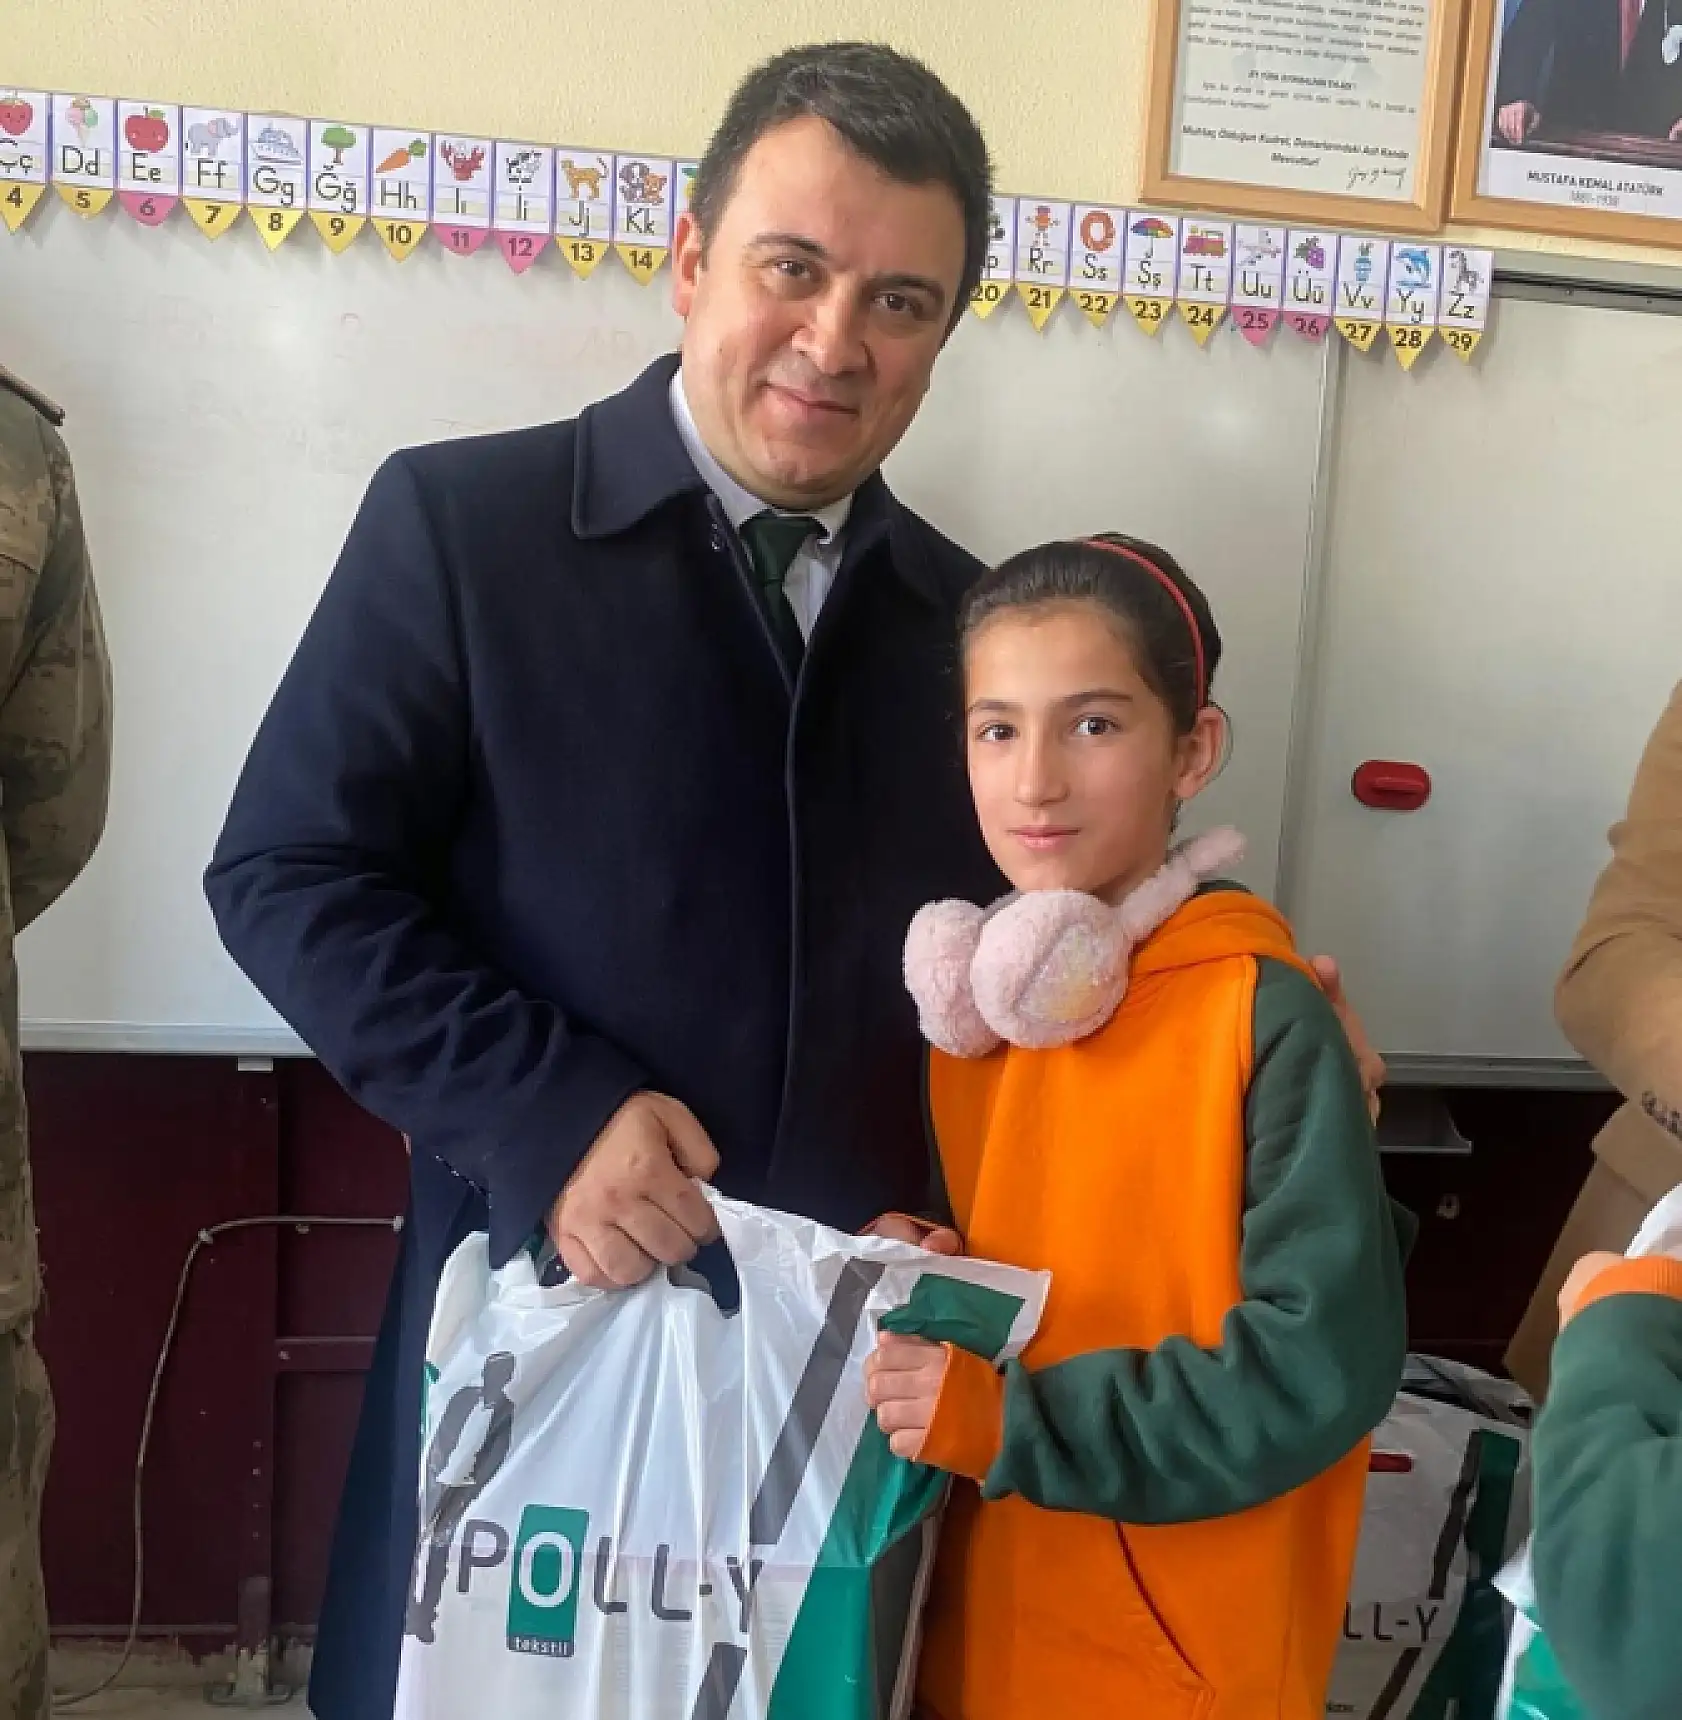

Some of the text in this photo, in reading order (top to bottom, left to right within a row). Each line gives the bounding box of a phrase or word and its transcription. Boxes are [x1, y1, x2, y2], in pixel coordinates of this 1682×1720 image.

[62, 145, 99, 176] Dd
[132, 153, 161, 182] Ee
[197, 158, 227, 188] Ff
[5, 186, 23, 208] 4
[253, 165, 294, 208] Gg
[315, 165, 357, 214] Ğğ
[381, 179, 417, 210] Hh
[78, 191, 91, 208] 5
[140, 199, 156, 217] 6
[205, 205, 222, 224] 7
[268, 212, 283, 231] 8
[569, 200, 590, 238] Jj
[626, 205, 655, 236] Kk
[330, 218, 345, 236] 9
[386, 224, 412, 244] 10
[451, 231, 470, 249] 11
[508, 237, 533, 257] 12
[571, 243, 595, 262] 13
[629, 251, 653, 270] 14
[1028, 247, 1054, 274] Rr
[1083, 252, 1108, 281] Ss
[1190, 263, 1214, 292] Tt
[1242, 270, 1272, 299] Uu
[970, 284, 999, 302] 20
[1029, 287, 1051, 308] 21
[1080, 293, 1109, 314] 22
[1343, 281, 1374, 309] Vv
[1135, 300, 1162, 321] 23
[1187, 305, 1214, 327] 24
[1399, 288, 1425, 324] Yy
[1449, 292, 1475, 319] Zz
[1242, 310, 1269, 331] 25
[1295, 317, 1320, 337] 26
[1345, 321, 1372, 342] 27
[1395, 328, 1422, 348] 28
[1450, 332, 1472, 352] 29
[457, 1518, 763, 1632] POLL-Y
[1343, 1601, 1440, 1642] LL-Y
